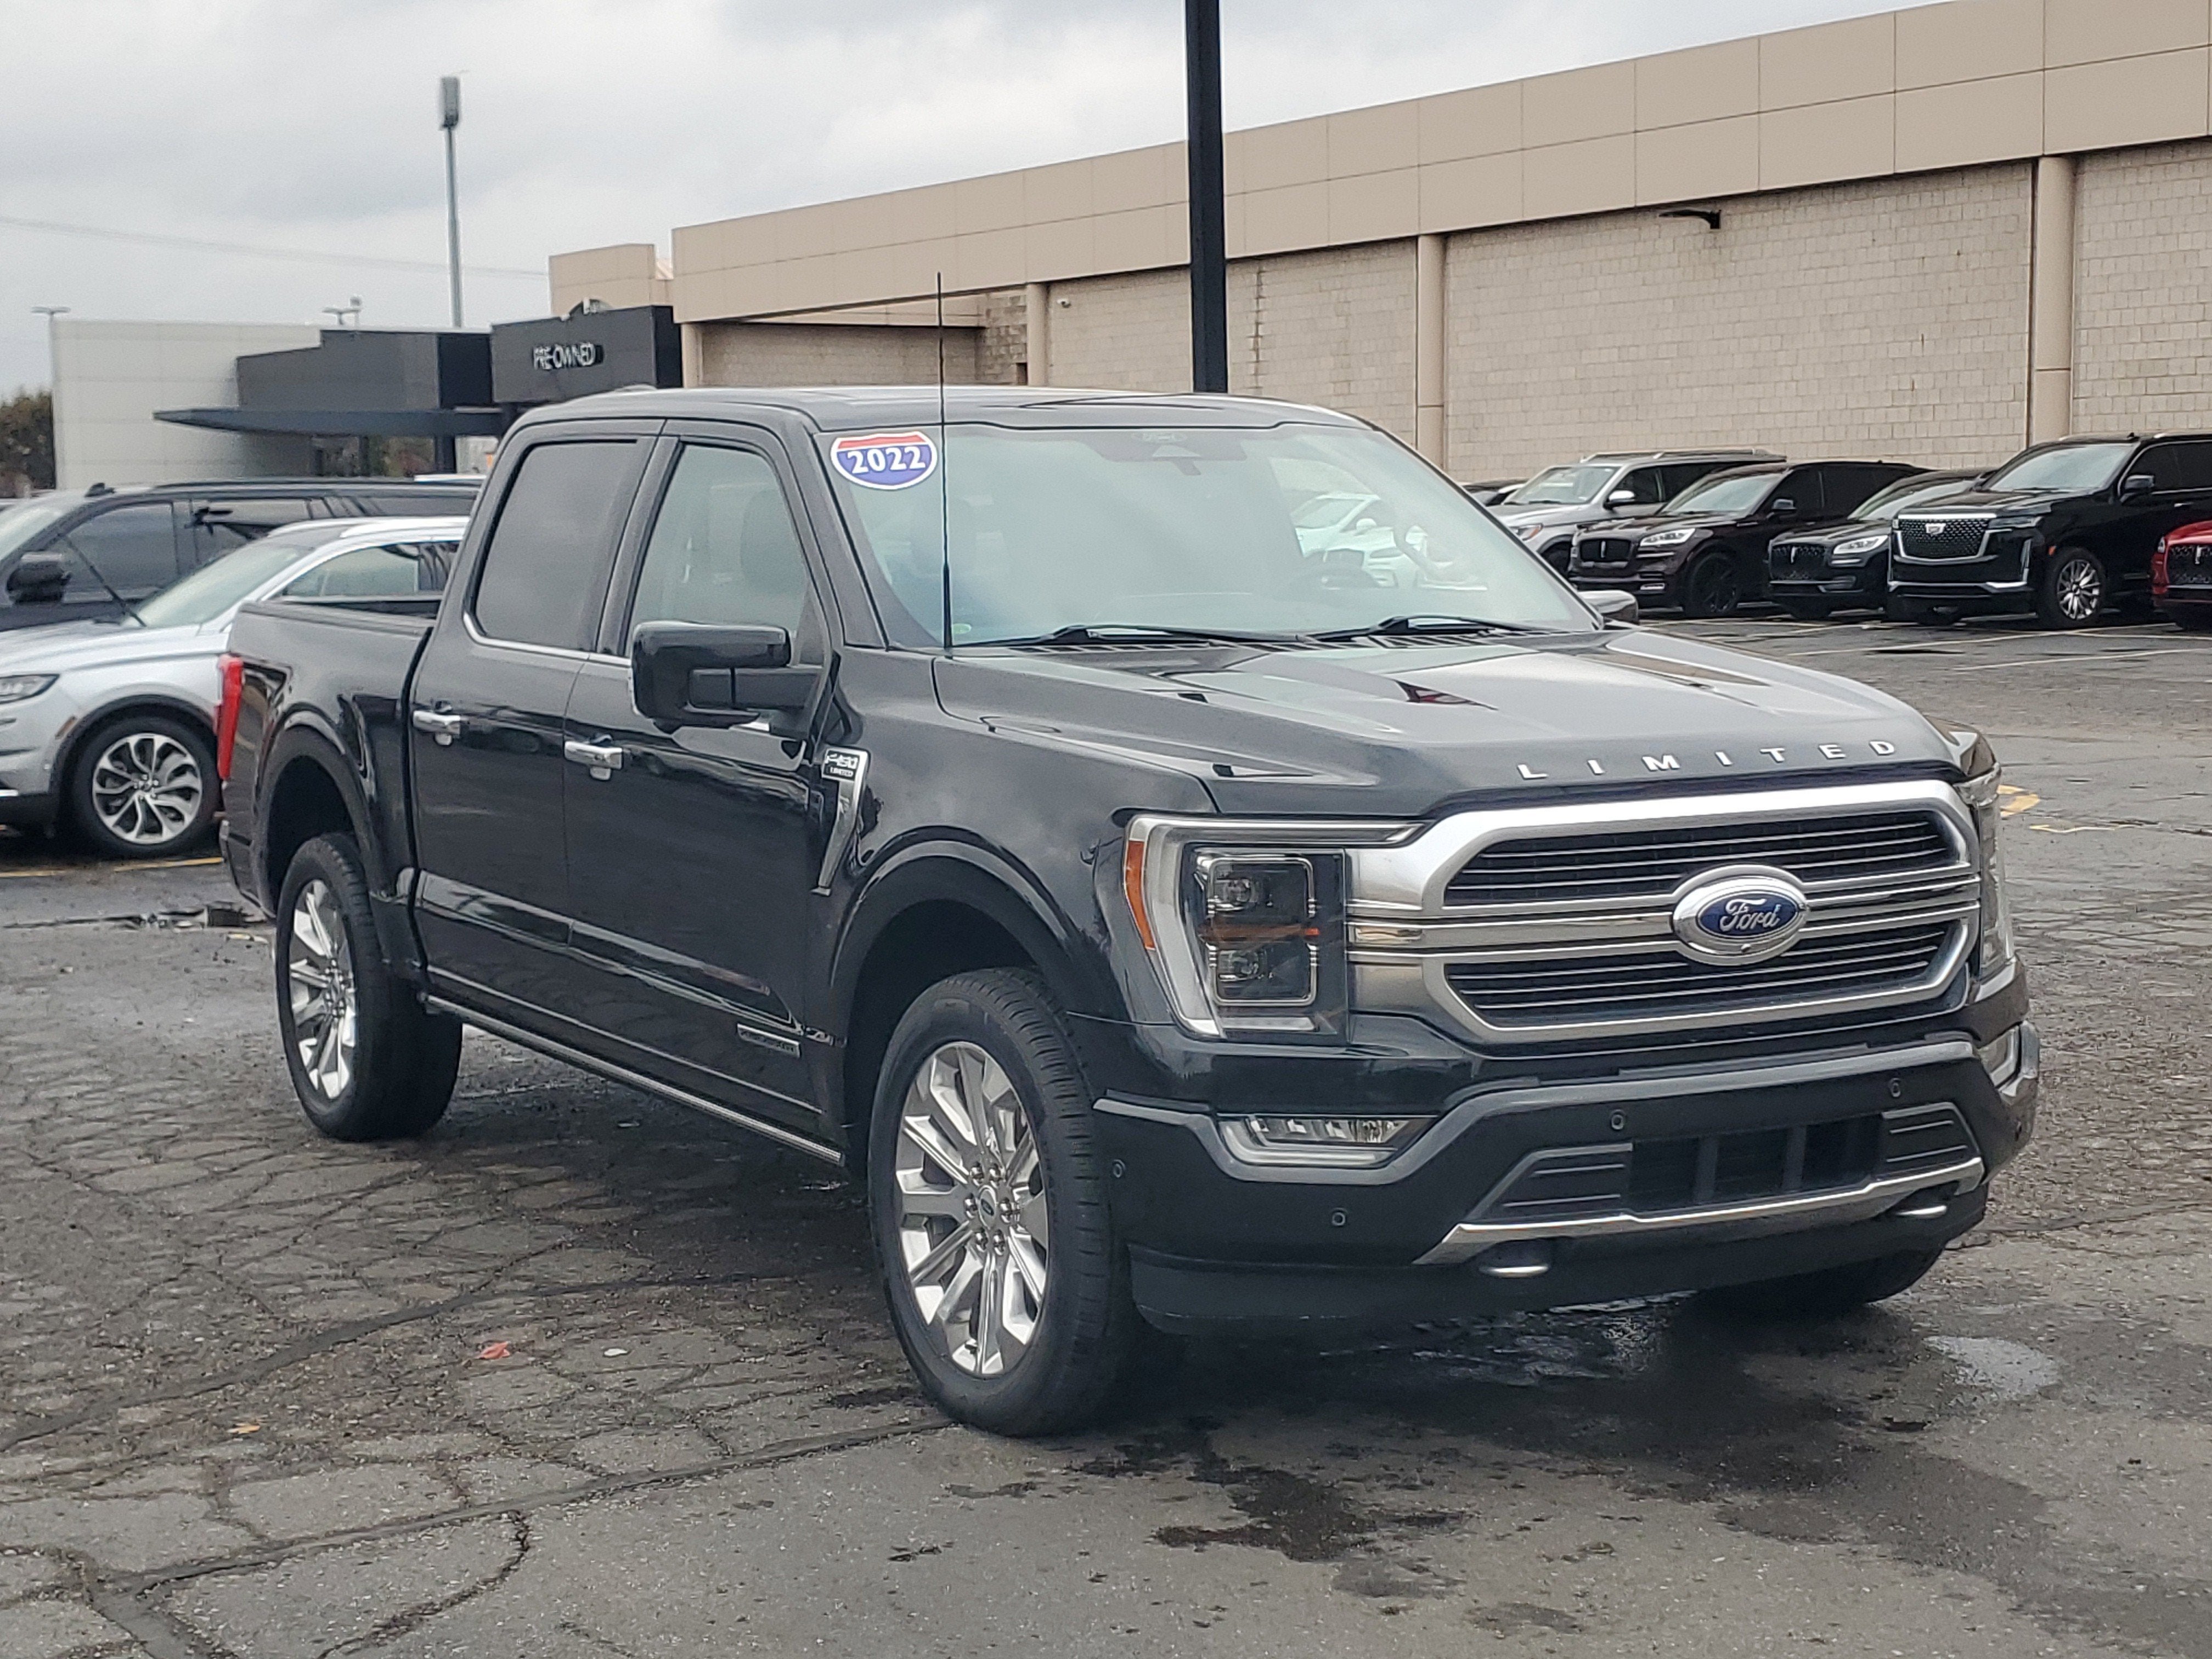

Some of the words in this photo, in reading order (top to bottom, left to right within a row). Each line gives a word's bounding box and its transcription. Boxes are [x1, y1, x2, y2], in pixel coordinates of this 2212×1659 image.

[848, 446, 926, 473] 2022
[1516, 741, 1895, 780] LIMITED
[1720, 899, 1781, 931] Ford
